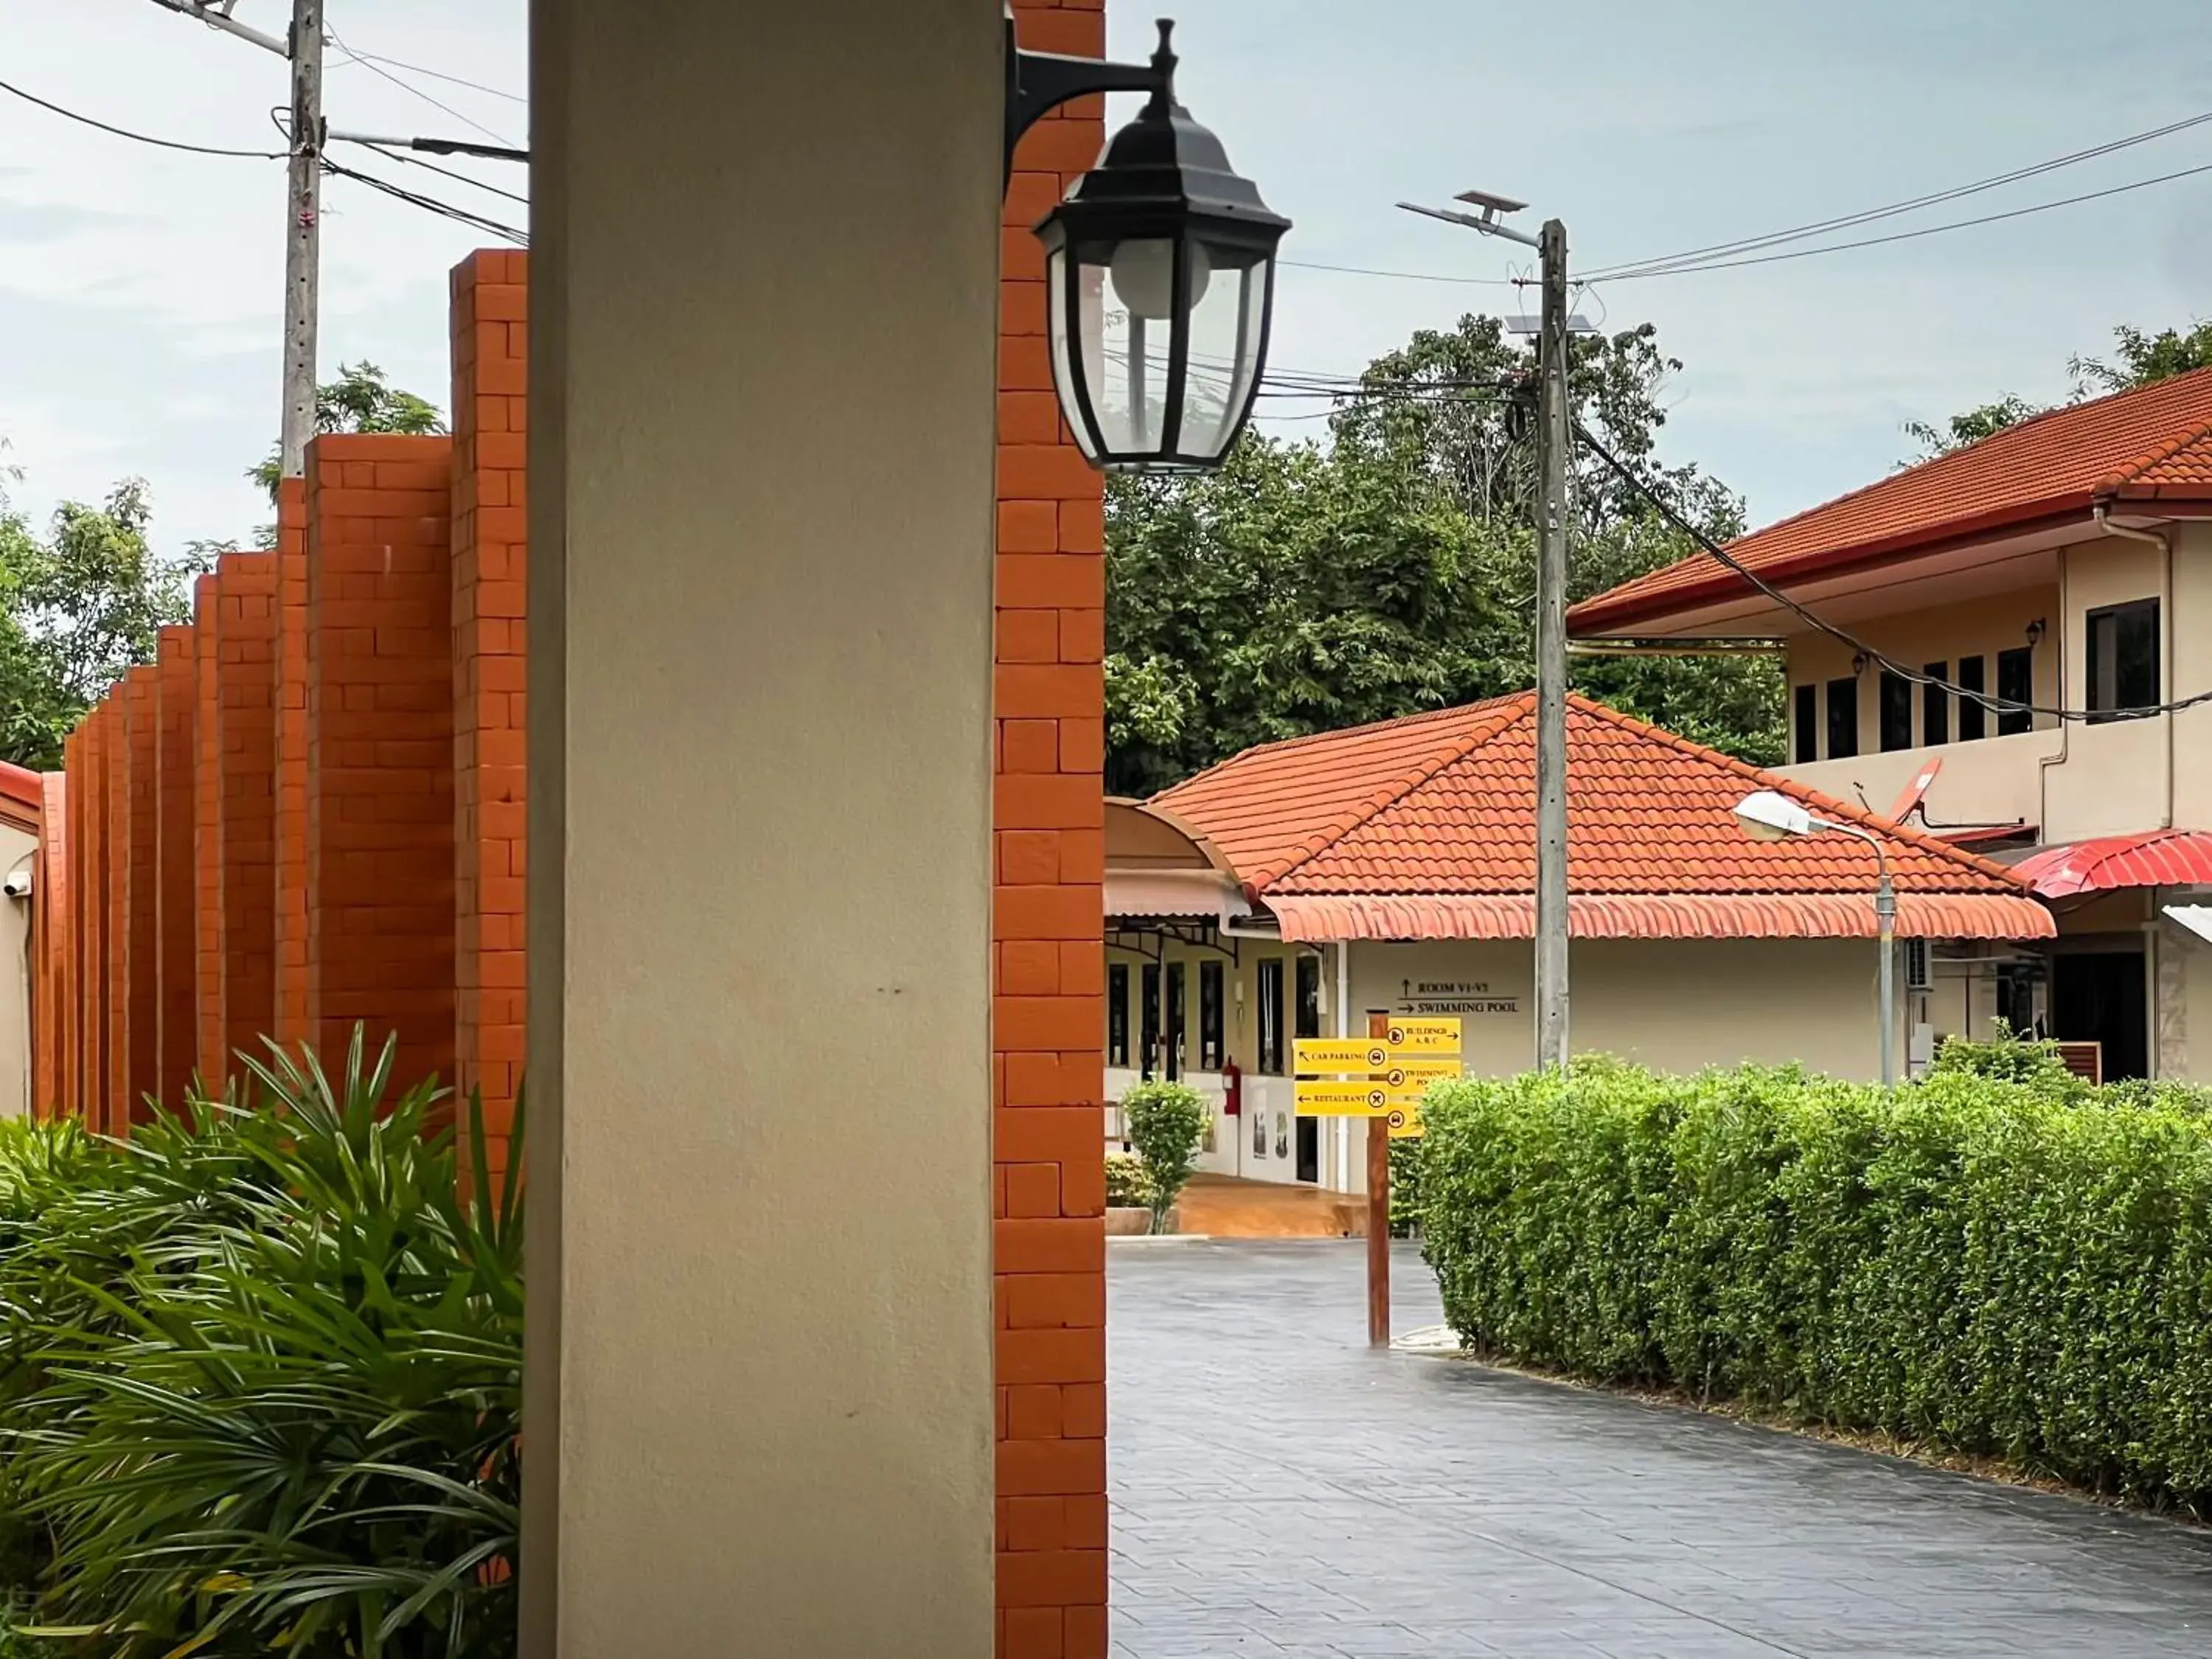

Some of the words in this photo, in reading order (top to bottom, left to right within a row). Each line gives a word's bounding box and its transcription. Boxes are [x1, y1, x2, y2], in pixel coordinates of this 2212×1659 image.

[1418, 982, 1454, 993] ROOM
[1417, 1003, 1484, 1013] SWIMMING
[1487, 1003, 1519, 1012] POOL
